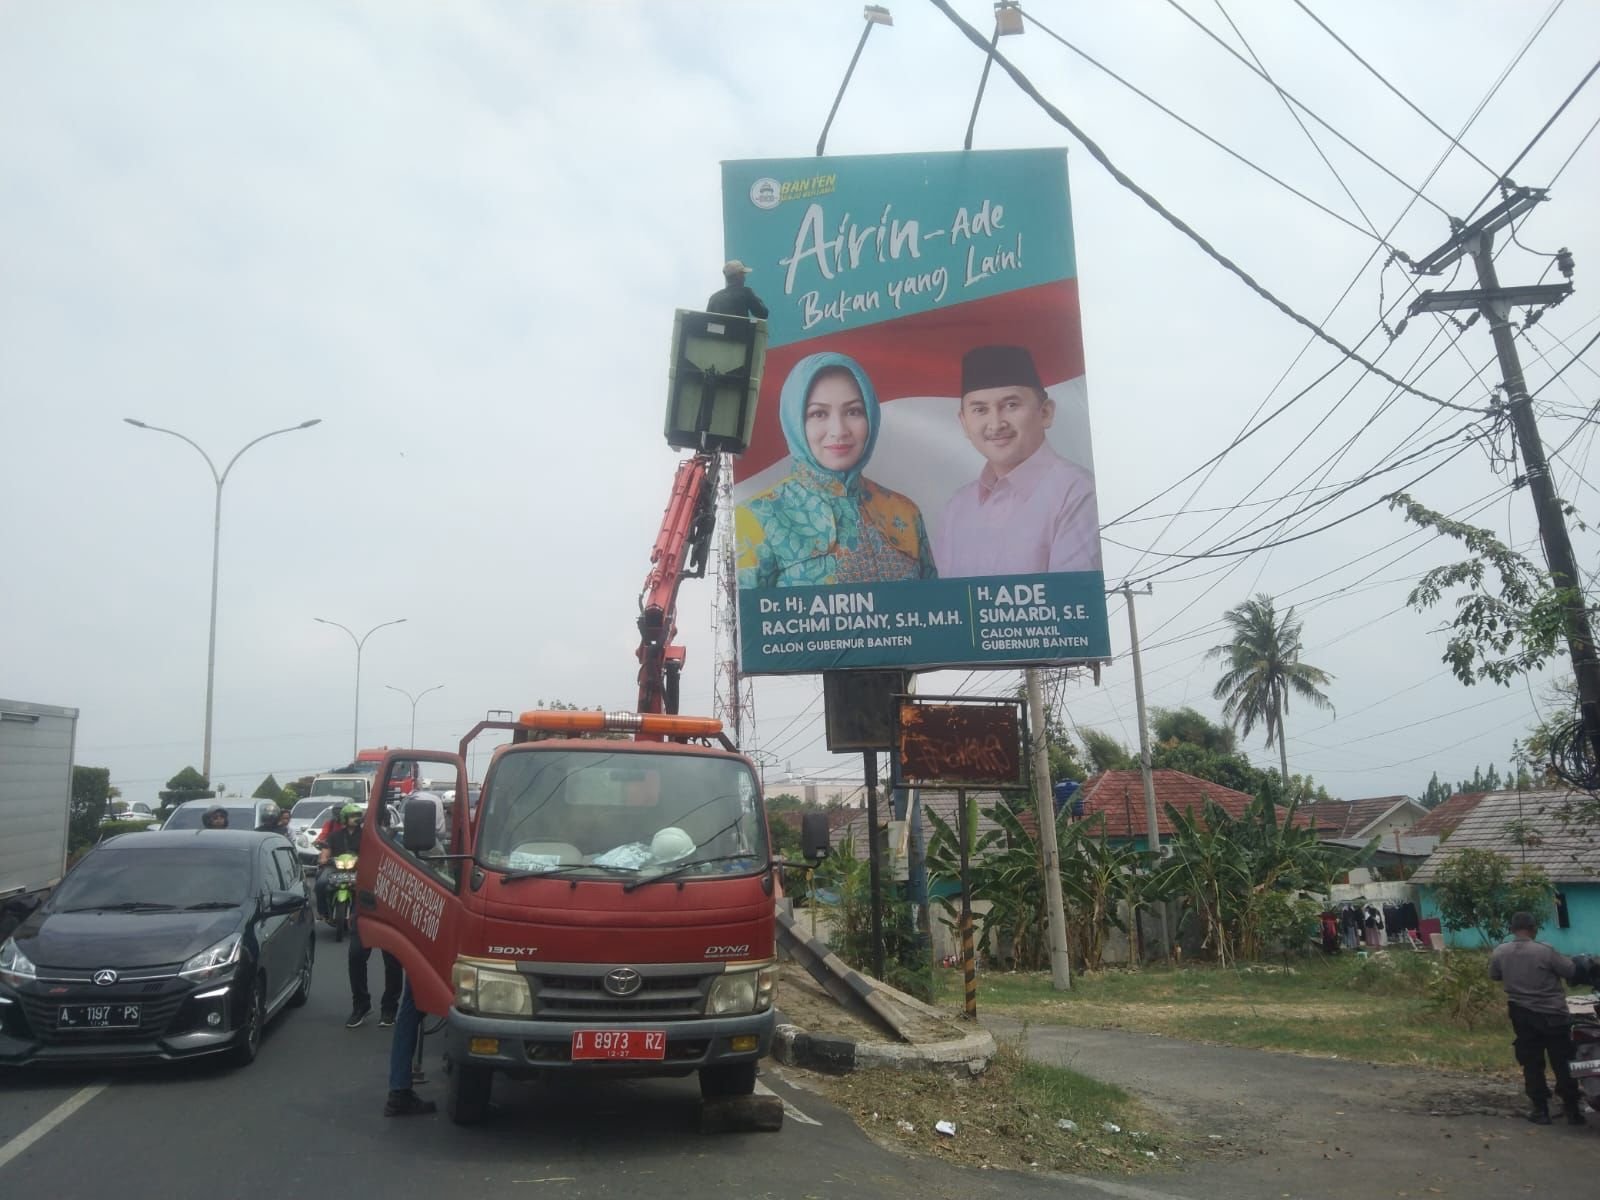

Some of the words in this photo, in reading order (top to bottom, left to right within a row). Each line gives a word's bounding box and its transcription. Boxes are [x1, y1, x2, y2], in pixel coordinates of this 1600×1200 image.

[799, 290, 880, 330] Bukan
[887, 266, 948, 310] yang
[964, 232, 1022, 287] Lain!
[760, 598, 781, 613] Dr.
[785, 596, 807, 614] Hj.
[809, 592, 874, 616] AIRIN
[977, 586, 993, 601] H.
[994, 583, 1046, 606] ADE
[979, 606, 1060, 623] SUMARDI,
[1063, 604, 1089, 620] S.E.
[762, 617, 830, 636] RACHMI
[835, 614, 890, 631] DIANY,
[981, 628, 1022, 638] CALON
[1025, 625, 1060, 637] WAKIL
[762, 642, 804, 655] CALON
[807, 638, 865, 652] GUBERNUR
[867, 635, 912, 648] BANTEN
[982, 639, 1040, 650] GUBERNUR
[1043, 637, 1088, 648] BANTEN
[374, 872, 390, 902] SMS
[378, 852, 408, 889] LAYANAN
[404, 872, 446, 918] PENGADUAN
[705, 944, 749, 954] DYNA
[61, 1007, 69, 1021] A
[87, 1006, 111, 1021] 1197
[124, 1006, 139, 1020] PS
[575, 1033, 584, 1049] A
[594, 1032, 629, 1049] 8973
[645, 1033, 663, 1049] RZ
